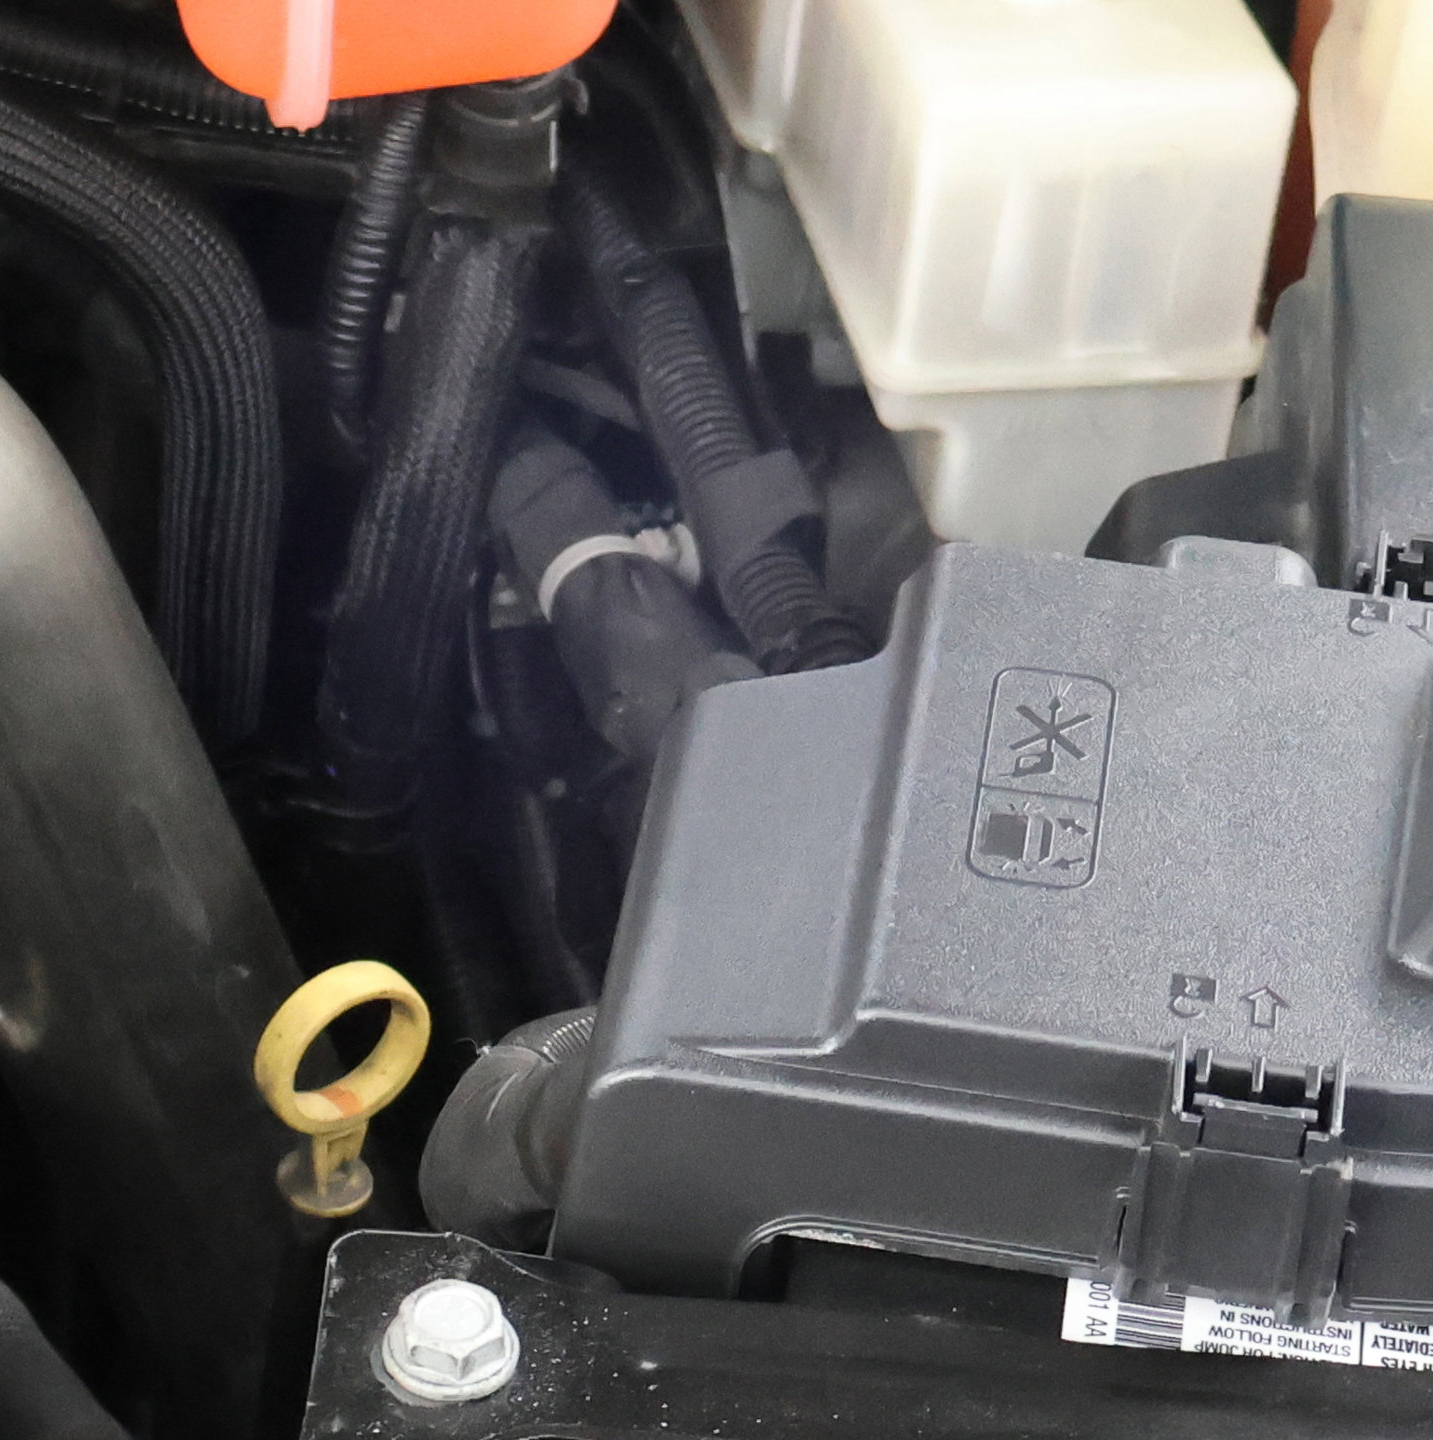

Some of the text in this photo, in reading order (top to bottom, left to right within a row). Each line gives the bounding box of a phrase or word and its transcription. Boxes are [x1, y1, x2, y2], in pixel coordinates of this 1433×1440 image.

[1220, 1309, 1235, 1321] IN
[1083, 1316, 1108, 1338] AA
[1194, 1340, 1239, 1356] JUMP
[1208, 1325, 1352, 1358] STARTING FOLLOW
